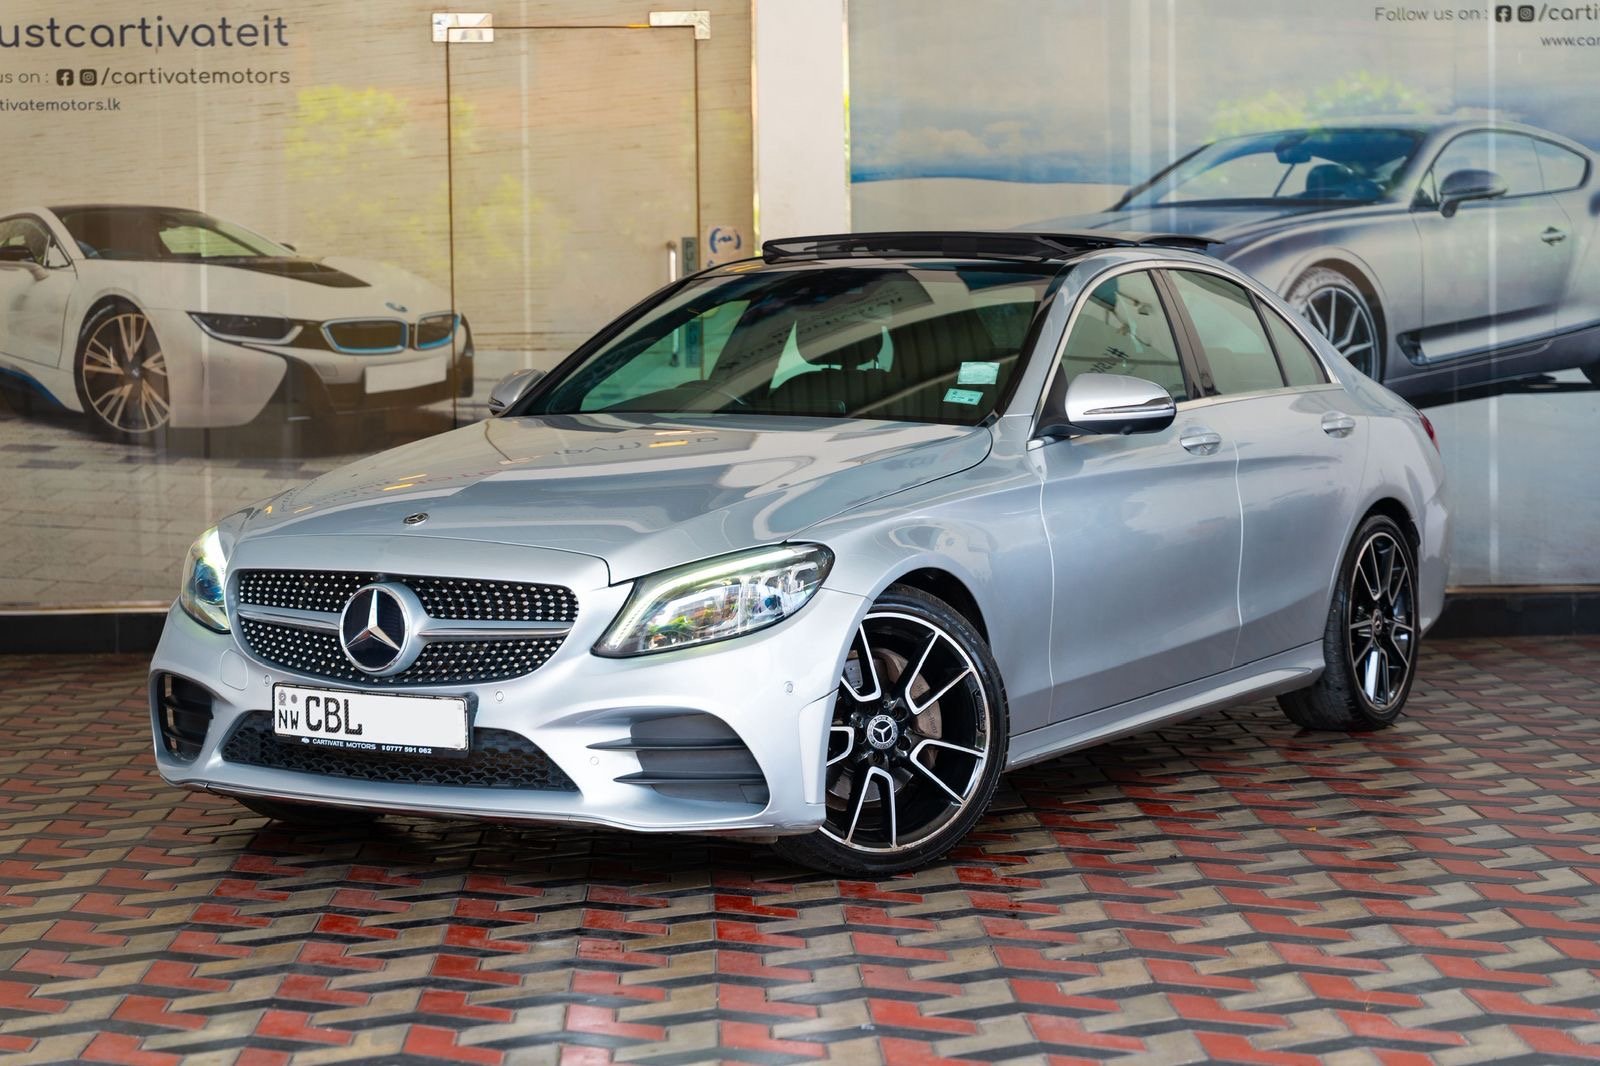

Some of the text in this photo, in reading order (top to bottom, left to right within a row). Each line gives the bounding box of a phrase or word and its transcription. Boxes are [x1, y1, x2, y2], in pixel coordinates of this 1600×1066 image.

[1375, 7, 1427, 21] Follow
[1433, 9, 1453, 21] us
[1458, 9, 1480, 21] on
[1538, 3, 1600, 22] /carti
[18, 72, 40, 84] on
[101, 67, 290, 86] /cartivatemotors
[278, 708, 299, 731] NW
[305, 695, 363, 736] CBL
[312, 738, 344, 747] CARTIVATE
[345, 742, 377, 750] MOTORS
